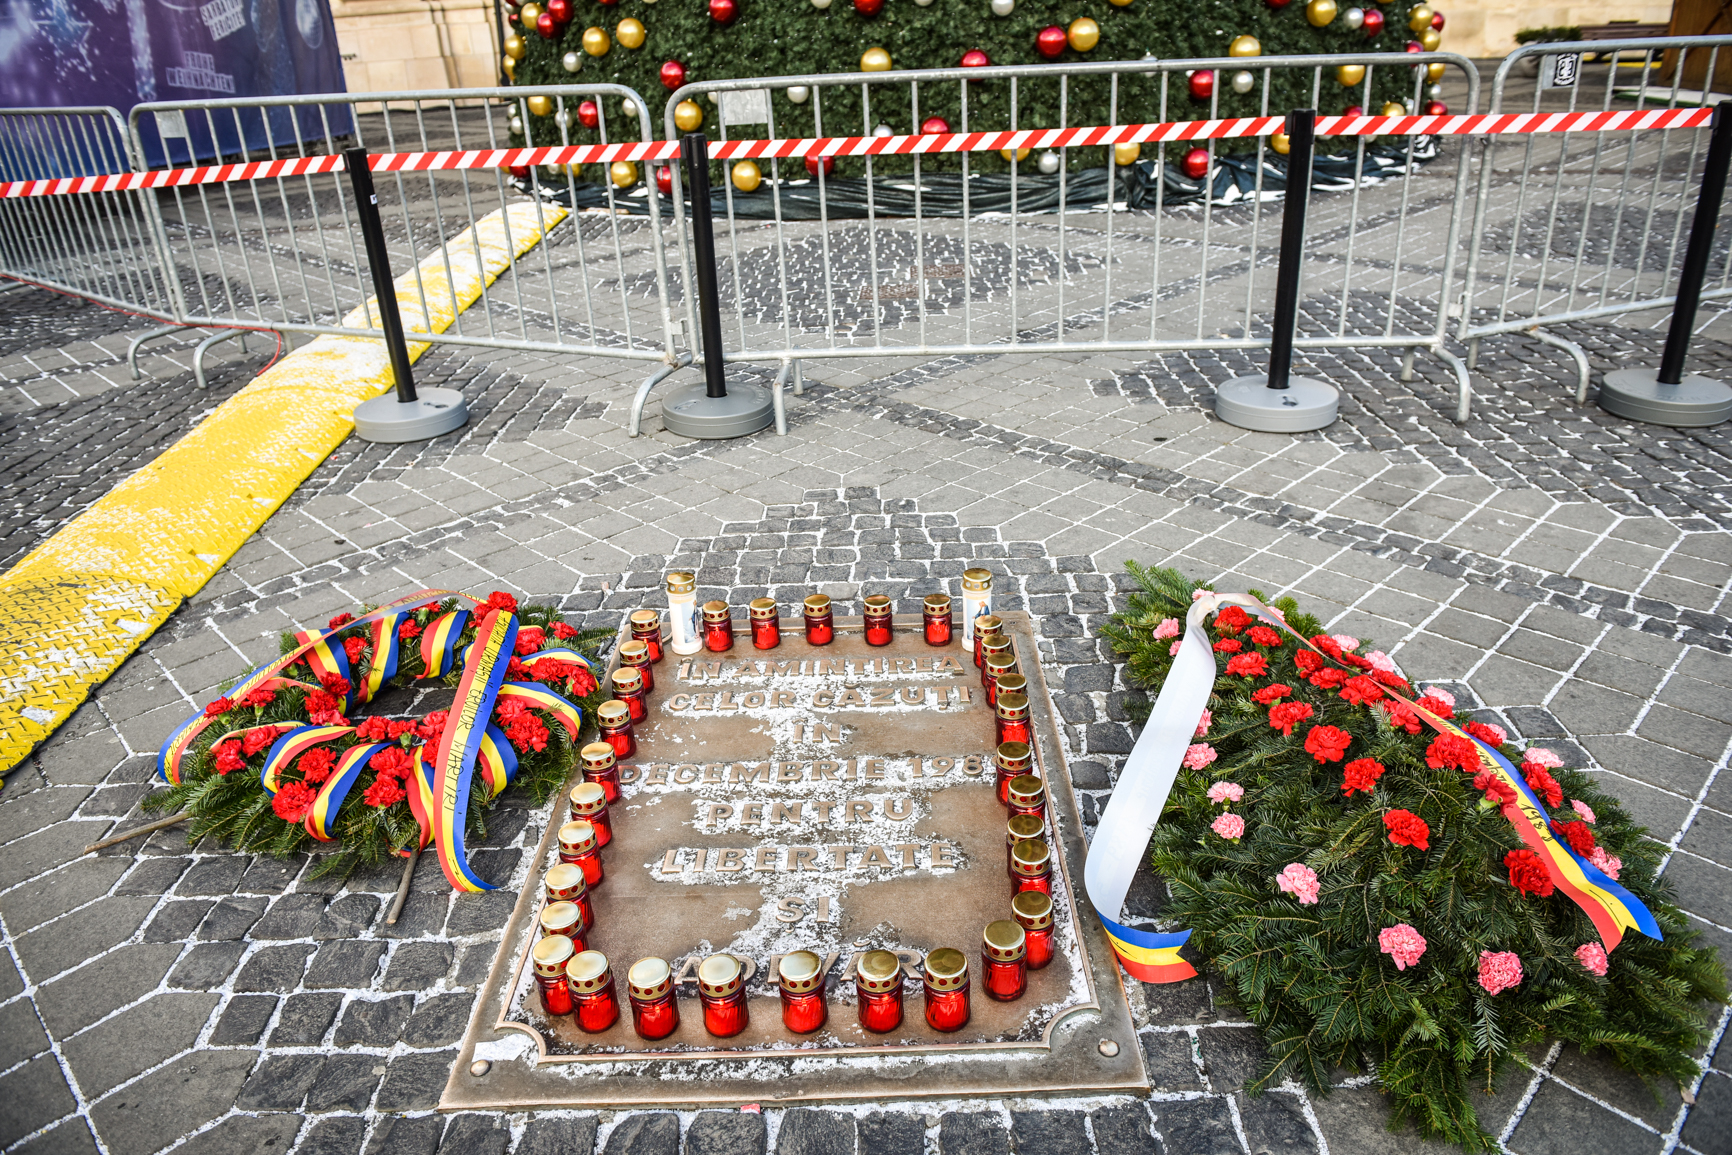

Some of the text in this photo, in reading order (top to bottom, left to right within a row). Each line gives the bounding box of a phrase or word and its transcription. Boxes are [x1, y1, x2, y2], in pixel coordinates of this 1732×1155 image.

[184, 51, 215, 73] FROHE
[679, 656, 965, 680] ÎN AMINTIREA
[669, 682, 971, 711] CELOR CĂZUȚI
[792, 717, 842, 744] ÎN
[618, 755, 998, 786] DECEMBRIE 198
[705, 799, 914, 827] PENTRU
[660, 842, 956, 875] LIBERTATE
[775, 896, 830, 933] ȘI
